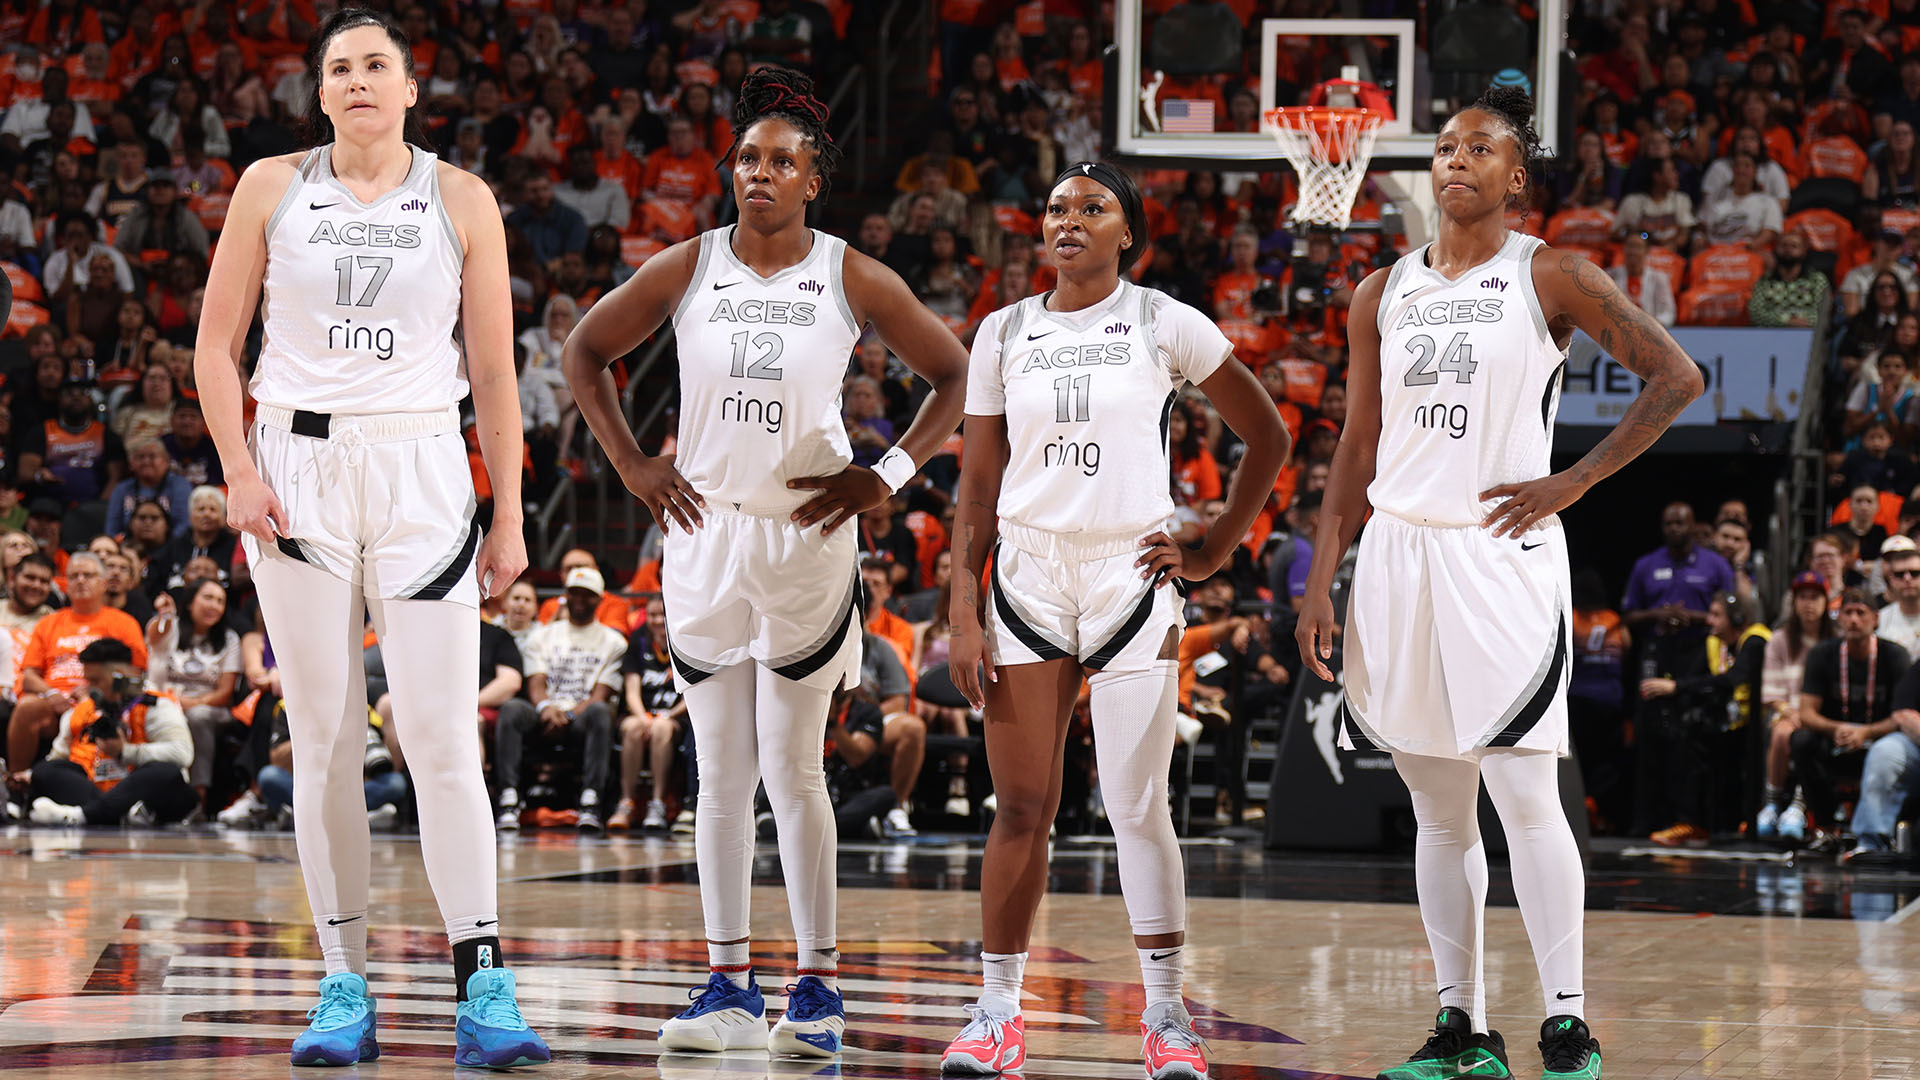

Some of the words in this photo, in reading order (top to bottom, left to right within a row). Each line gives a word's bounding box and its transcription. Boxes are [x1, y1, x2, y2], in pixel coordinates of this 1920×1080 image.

[401, 199, 428, 213] ally
[308, 220, 421, 249] ACES
[335, 255, 393, 307] 17
[798, 279, 825, 296] ally
[1480, 277, 1509, 292] ally
[708, 298, 817, 326] ACES
[1396, 298, 1504, 330] ACES
[329, 318, 394, 361] ring
[1104, 322, 1132, 336] ally
[730, 330, 784, 381] 12
[1022, 342, 1131, 373] ACES
[1404, 332, 1478, 387] 24
[722, 390, 783, 433] ring
[1053, 373, 1091, 423] 11
[1044, 435, 1101, 477] ring
